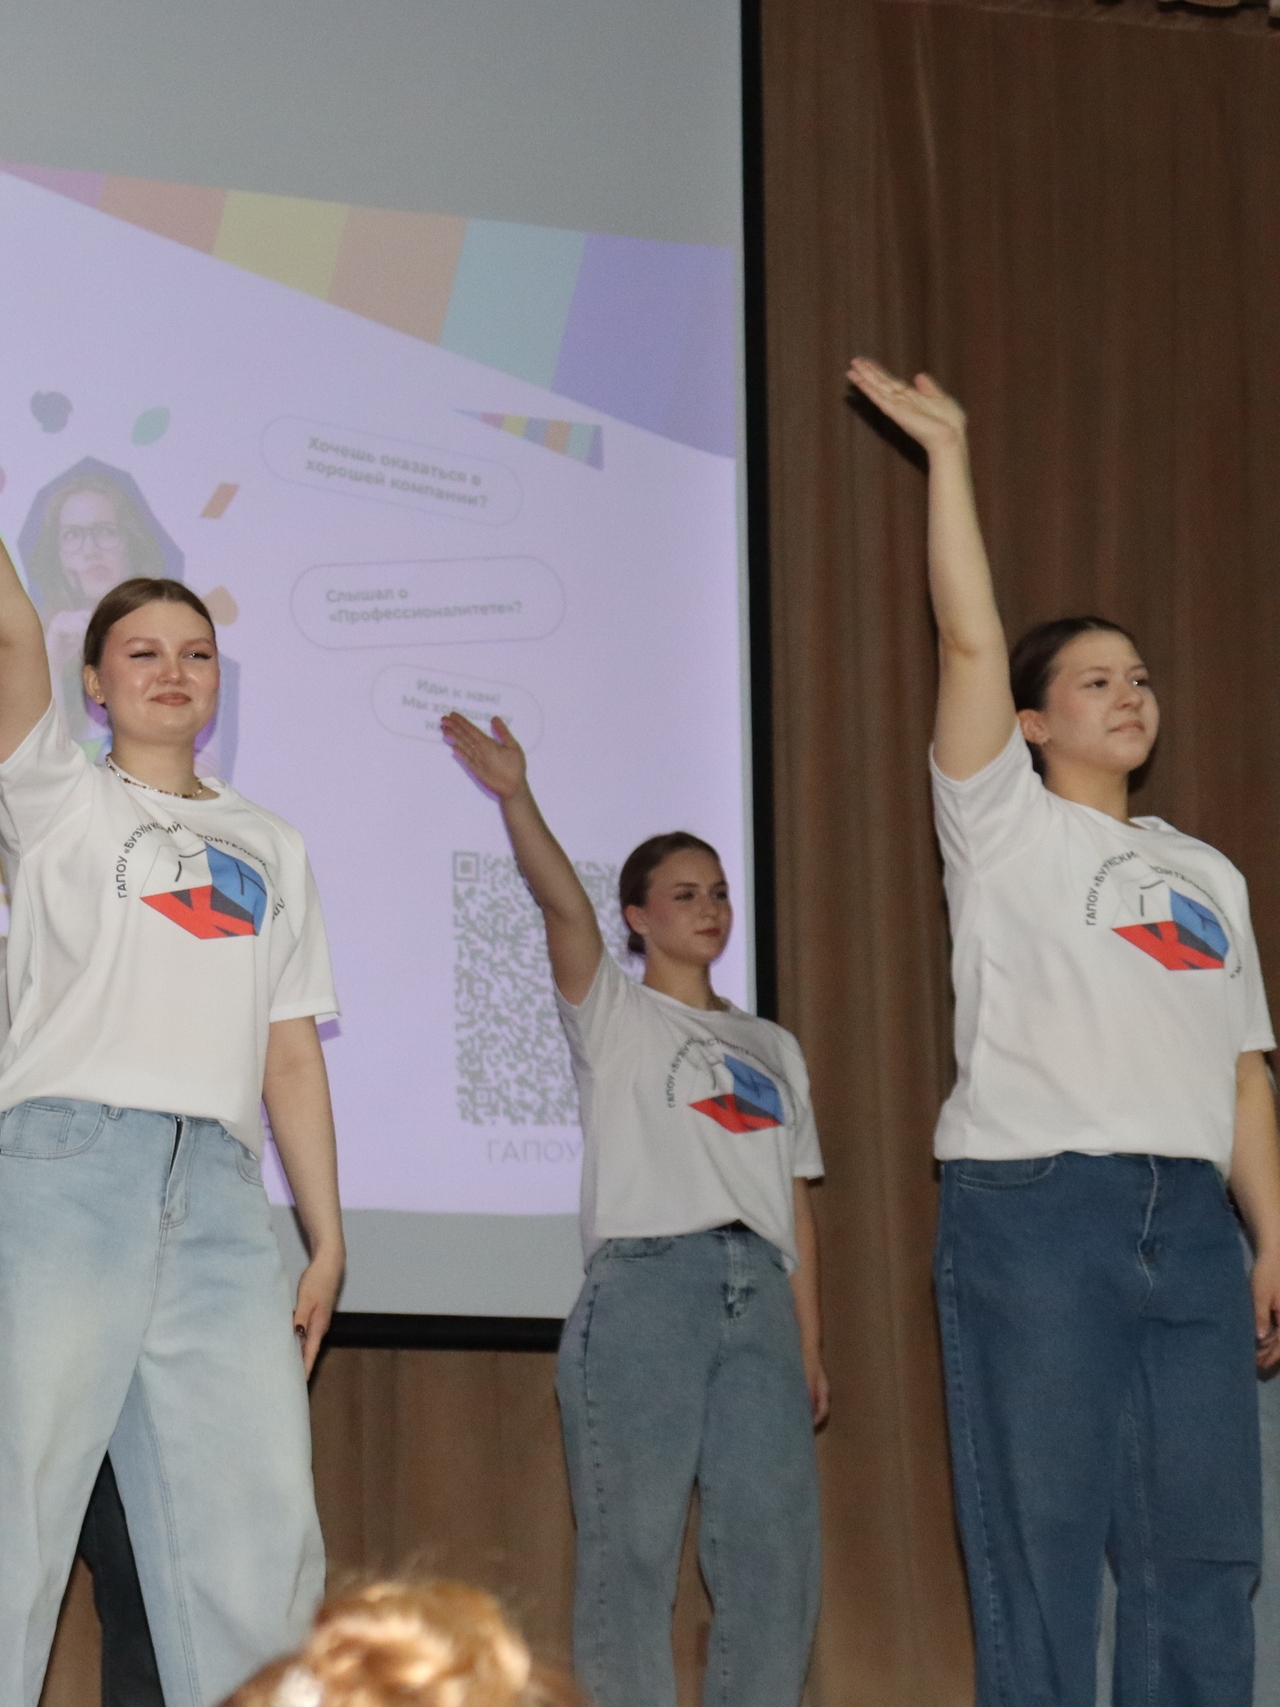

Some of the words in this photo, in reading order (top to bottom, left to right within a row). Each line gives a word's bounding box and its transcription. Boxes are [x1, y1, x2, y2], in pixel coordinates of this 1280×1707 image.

[305, 459, 386, 486] хорошей
[308, 435, 376, 463] Хочешь
[380, 454, 467, 483] оказаться
[115, 855, 128, 899] ГАПОУ
[1085, 887, 1099, 926] ГАПОУ
[486, 1138, 583, 1164] ГАПОУ
